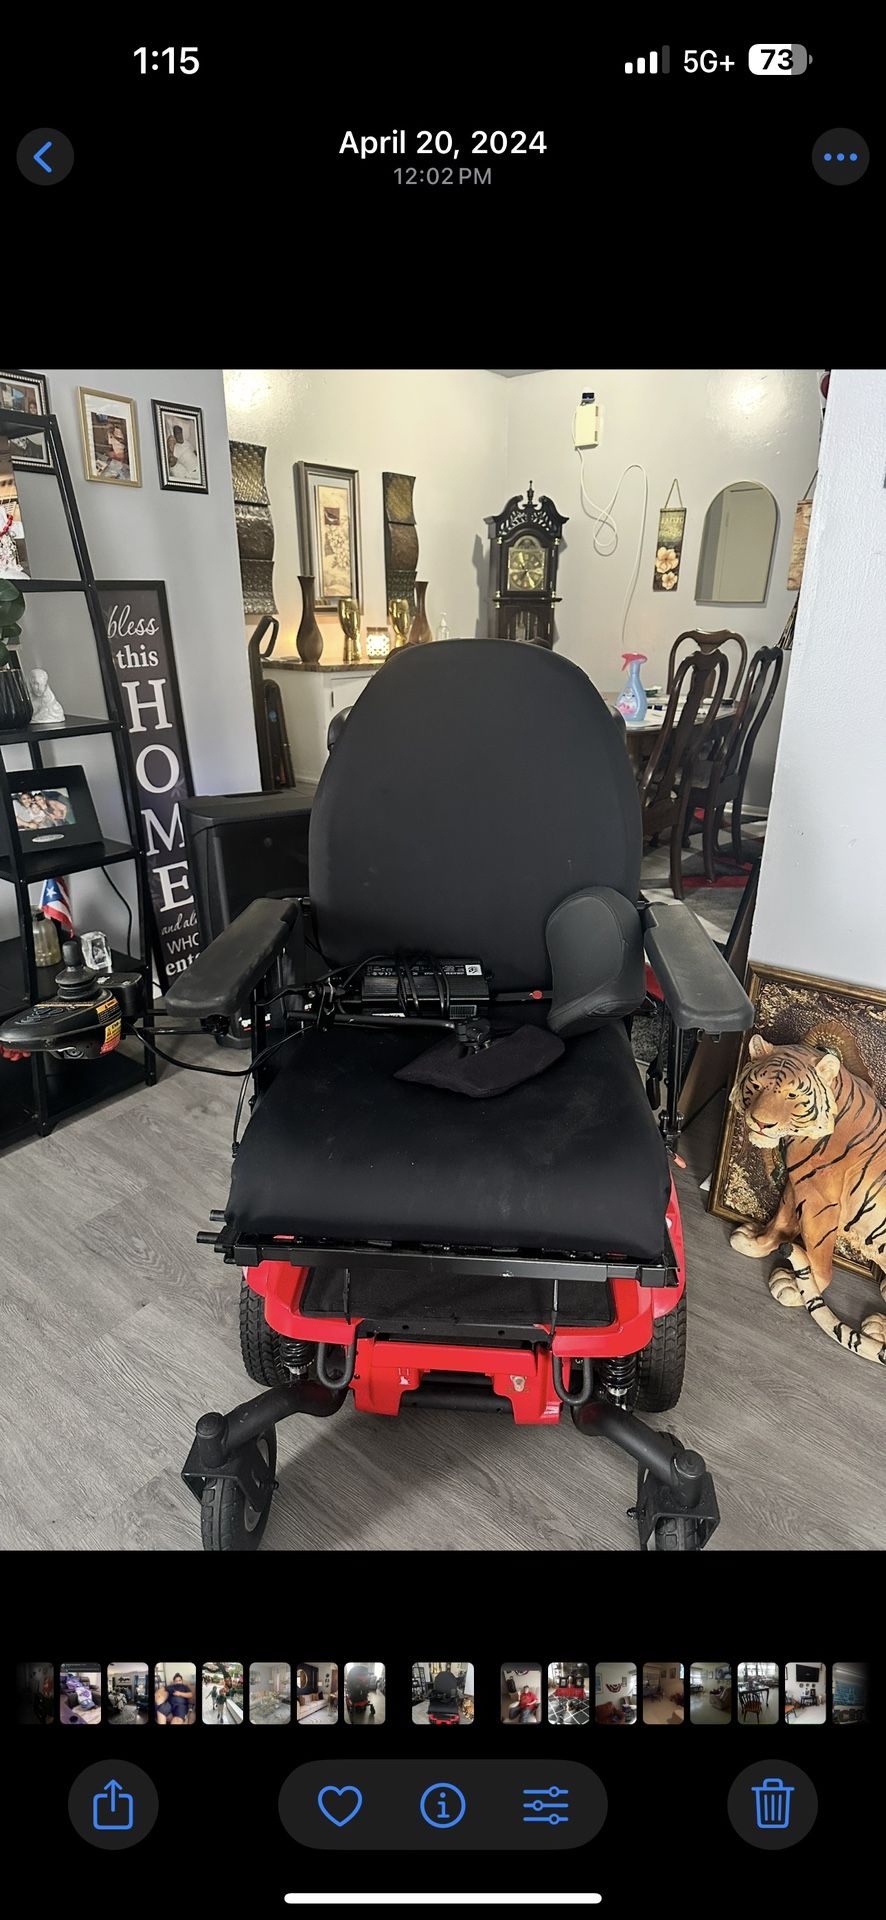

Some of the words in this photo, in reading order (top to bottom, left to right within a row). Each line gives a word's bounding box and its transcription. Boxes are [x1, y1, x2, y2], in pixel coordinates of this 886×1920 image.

[107, 604, 160, 639] bless
[116, 644, 159, 669] this
[161, 912, 183, 936] and
[165, 952, 201, 976] ent
